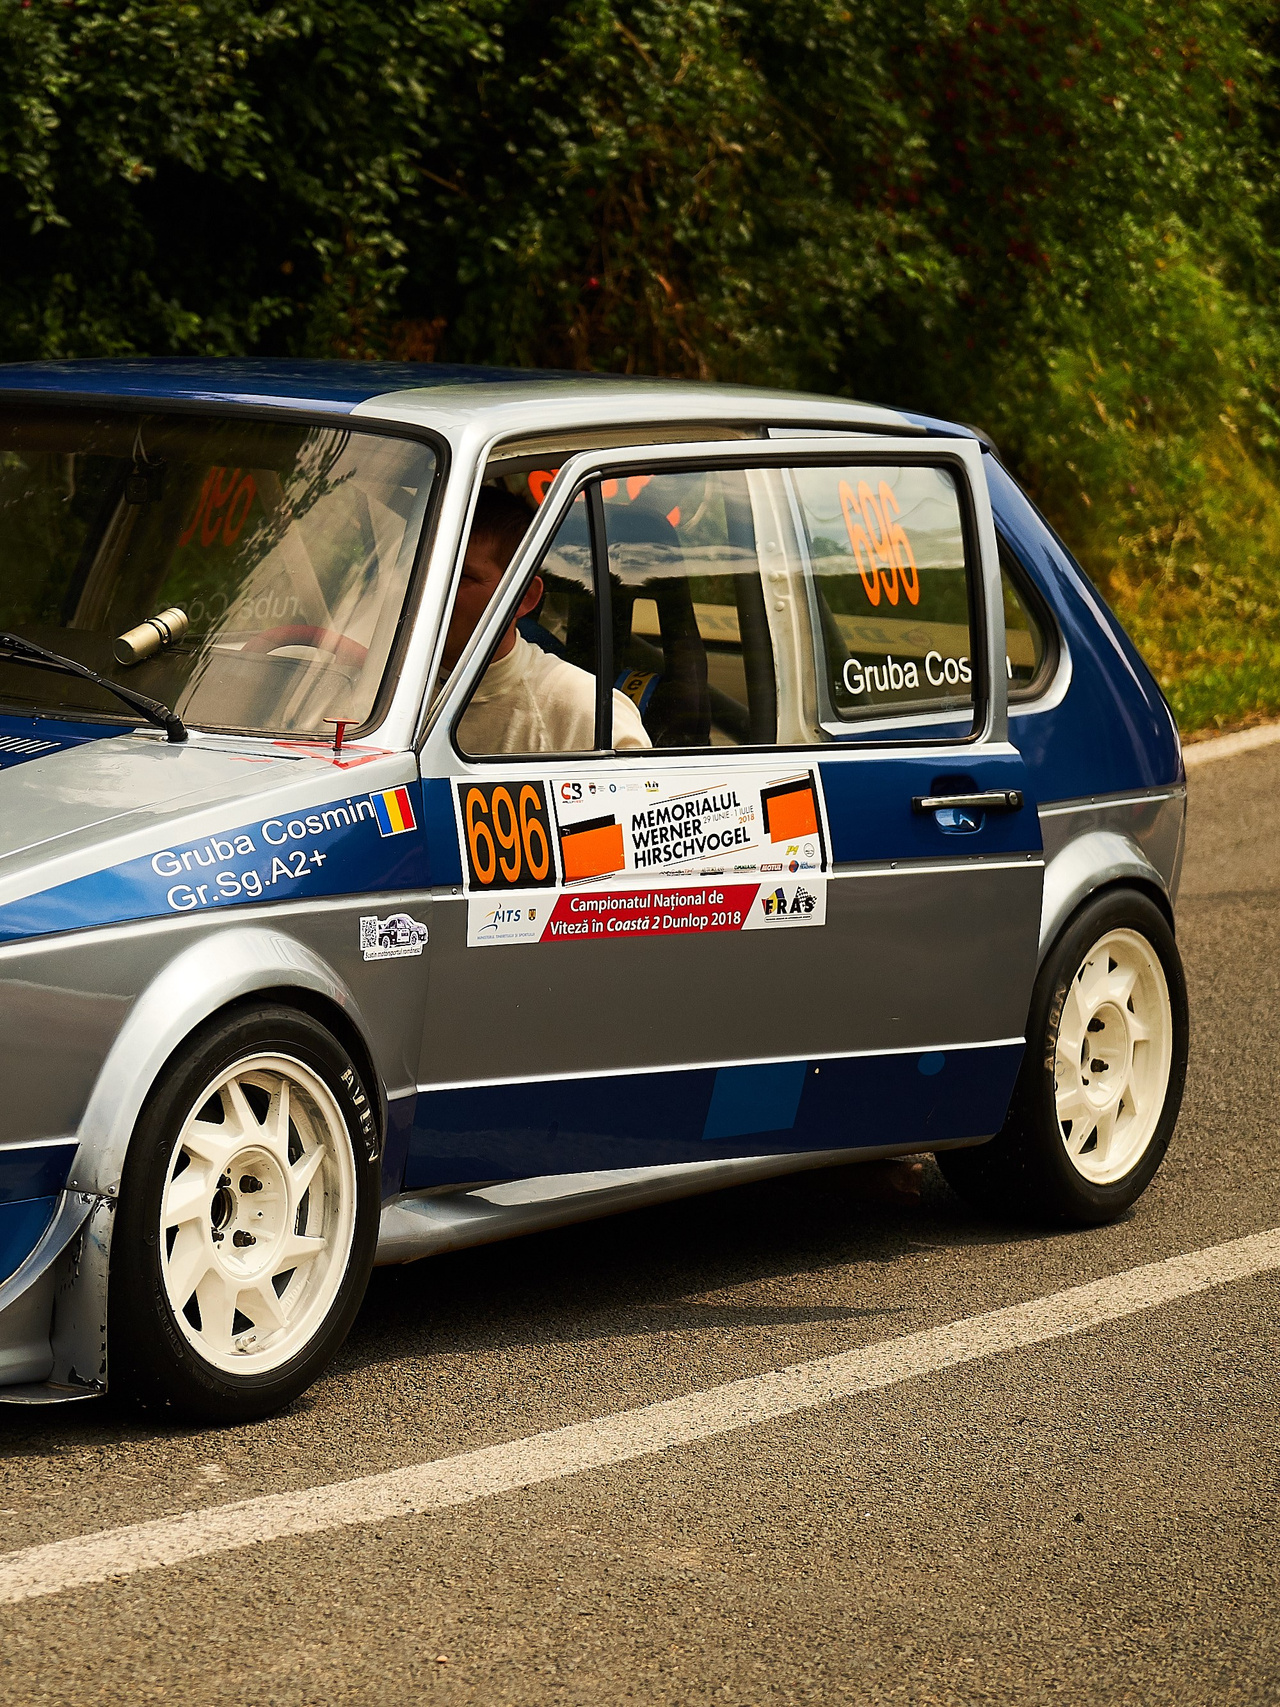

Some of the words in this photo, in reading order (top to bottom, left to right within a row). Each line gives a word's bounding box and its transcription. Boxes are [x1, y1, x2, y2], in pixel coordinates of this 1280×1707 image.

[838, 480, 919, 607] 696
[843, 655, 919, 695] Gruba
[631, 791, 740, 831] MEMORIALUL
[713, 812, 729, 823] IUNIE
[739, 805, 754, 815] IULIE
[738, 813, 755, 825] 2018
[151, 836, 256, 878] Gruba
[261, 799, 376, 846] Cosmin
[466, 785, 549, 885] 696
[631, 819, 703, 849] WERNER
[634, 826, 751, 869] HIRSCHVOGEL
[166, 850, 327, 911] Gr.Sg.A2+
[762, 863, 782, 872] MOTUL
[494, 909, 521, 923] MTS
[570, 894, 651, 914] Campionatul
[654, 891, 706, 911] Național
[708, 890, 724, 904] de
[765, 896, 814, 916] FRAS
[550, 918, 589, 935] Viteză
[592, 920, 604, 933] în
[607, 915, 650, 932] Coastă
[652, 916, 660, 930] 2
[663, 913, 709, 930] Dunlop
[711, 911, 742, 926] 2018
